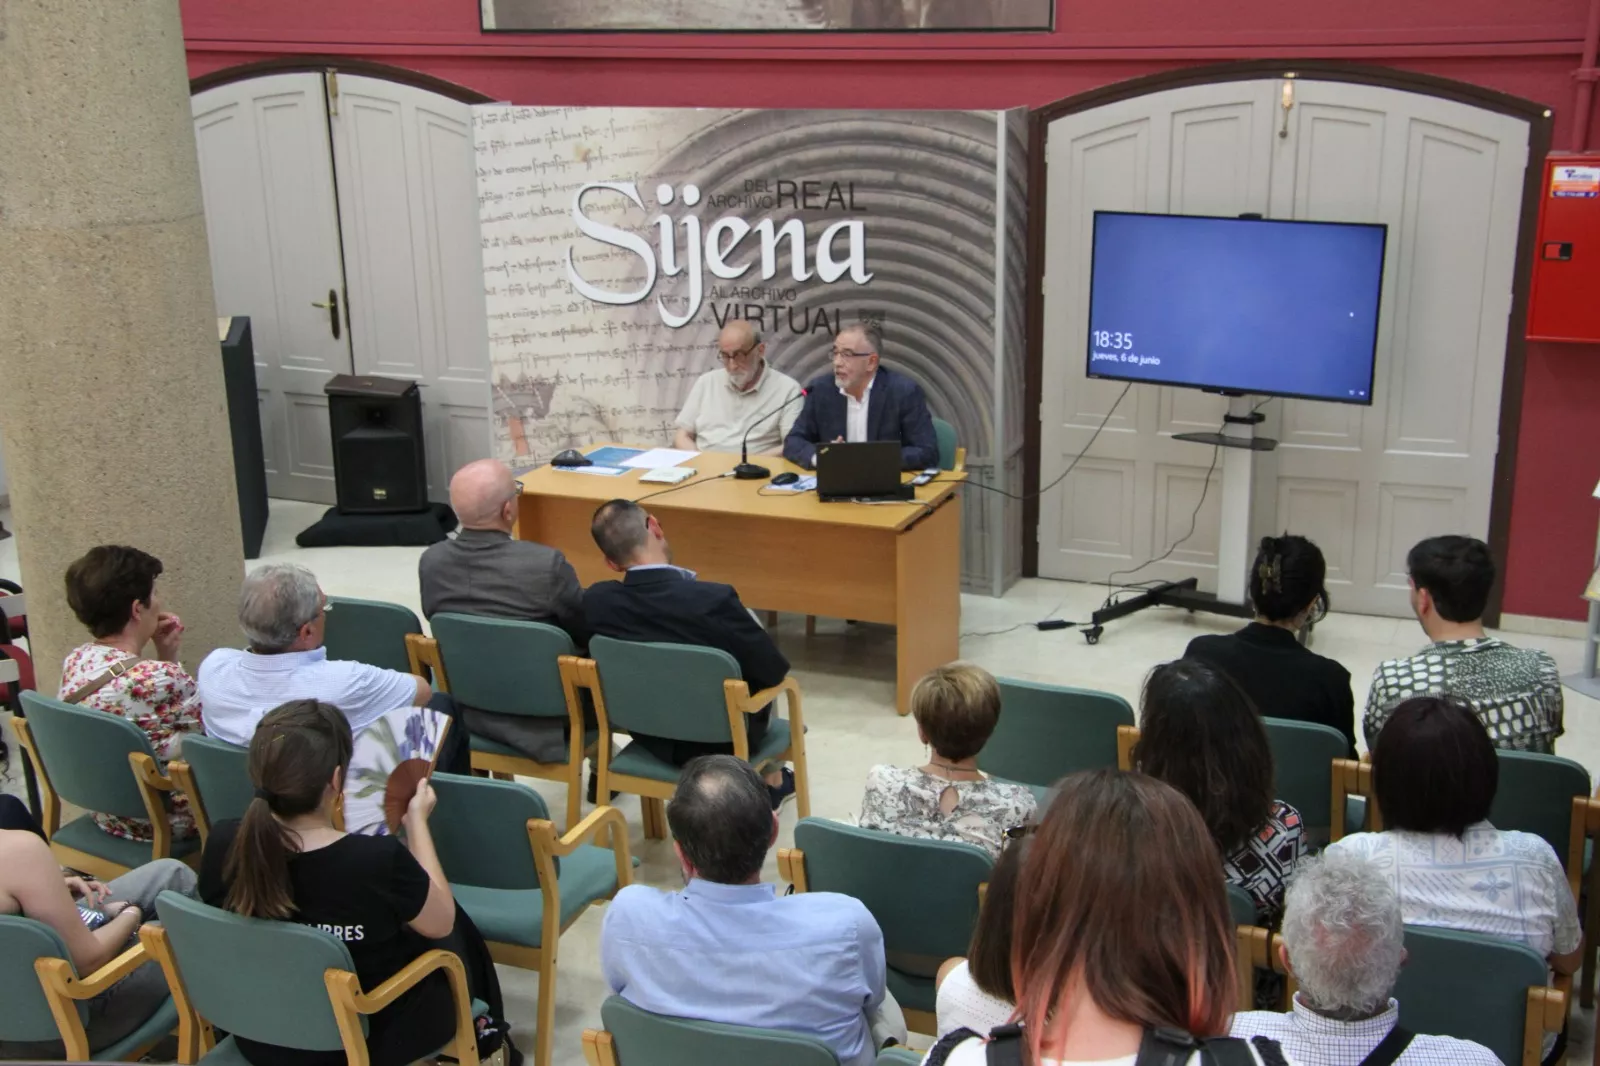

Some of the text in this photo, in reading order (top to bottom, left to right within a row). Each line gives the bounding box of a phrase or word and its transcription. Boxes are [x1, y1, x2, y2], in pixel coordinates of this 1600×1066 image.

[744, 179, 773, 193] DEL
[707, 194, 773, 209] ARCHIVO
[777, 180, 867, 211] REAL
[566, 181, 874, 329] Sijena
[710, 285, 797, 301] AL ARCHIVO
[1093, 330, 1133, 350] 18:35
[1092, 351, 1161, 366] jueves, 6 de junio
[307, 923, 364, 941] RES
